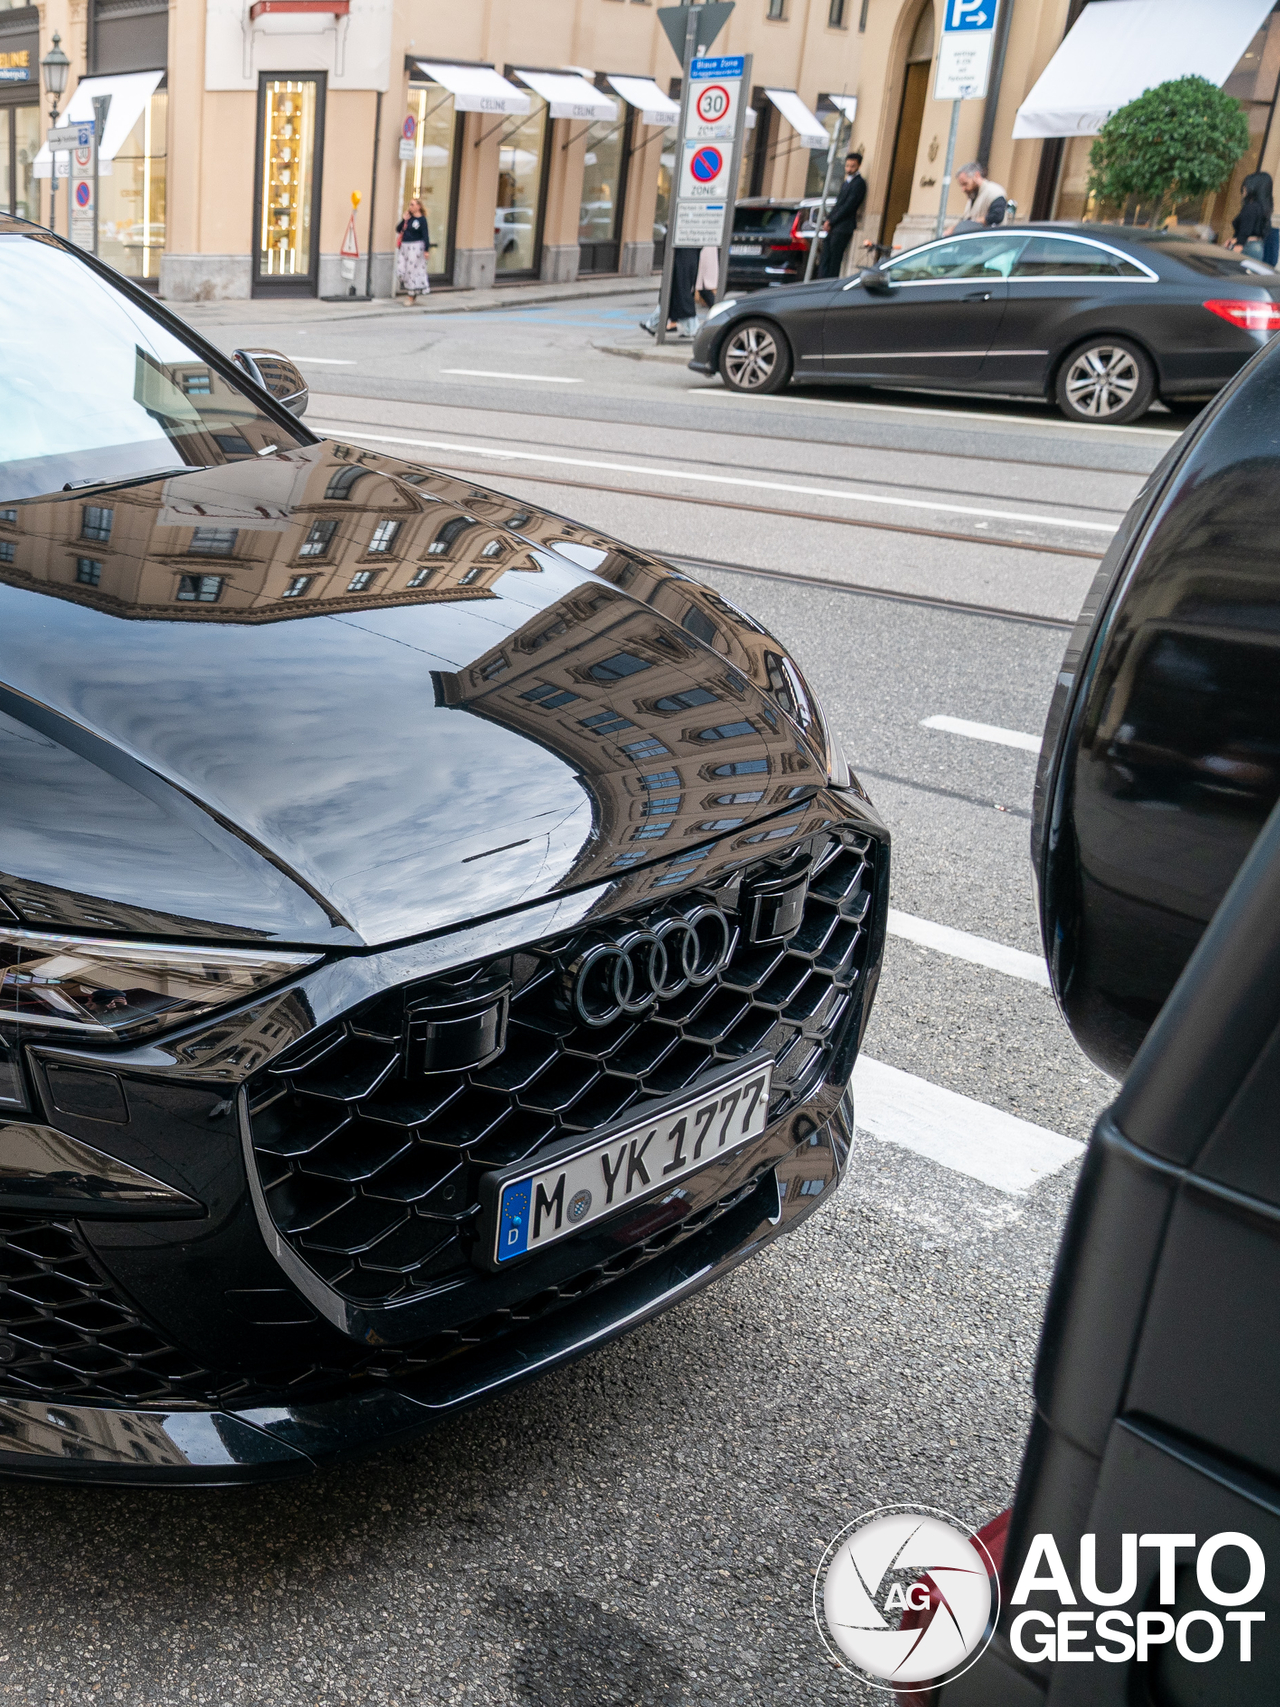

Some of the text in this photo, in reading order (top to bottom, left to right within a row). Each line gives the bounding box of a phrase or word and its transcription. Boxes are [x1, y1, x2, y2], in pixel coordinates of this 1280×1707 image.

[697, 59, 738, 69] Blaue Zone
[480, 98, 506, 111] CELINE
[703, 94, 723, 113] 30
[572, 104, 596, 117] CELINE
[655, 111, 676, 123] CELINE
[691, 185, 717, 196] ZONE
[532, 1172, 566, 1240] M
[600, 1129, 657, 1205] YK
[662, 1074, 766, 1176] 1777
[507, 1228, 519, 1246] D
